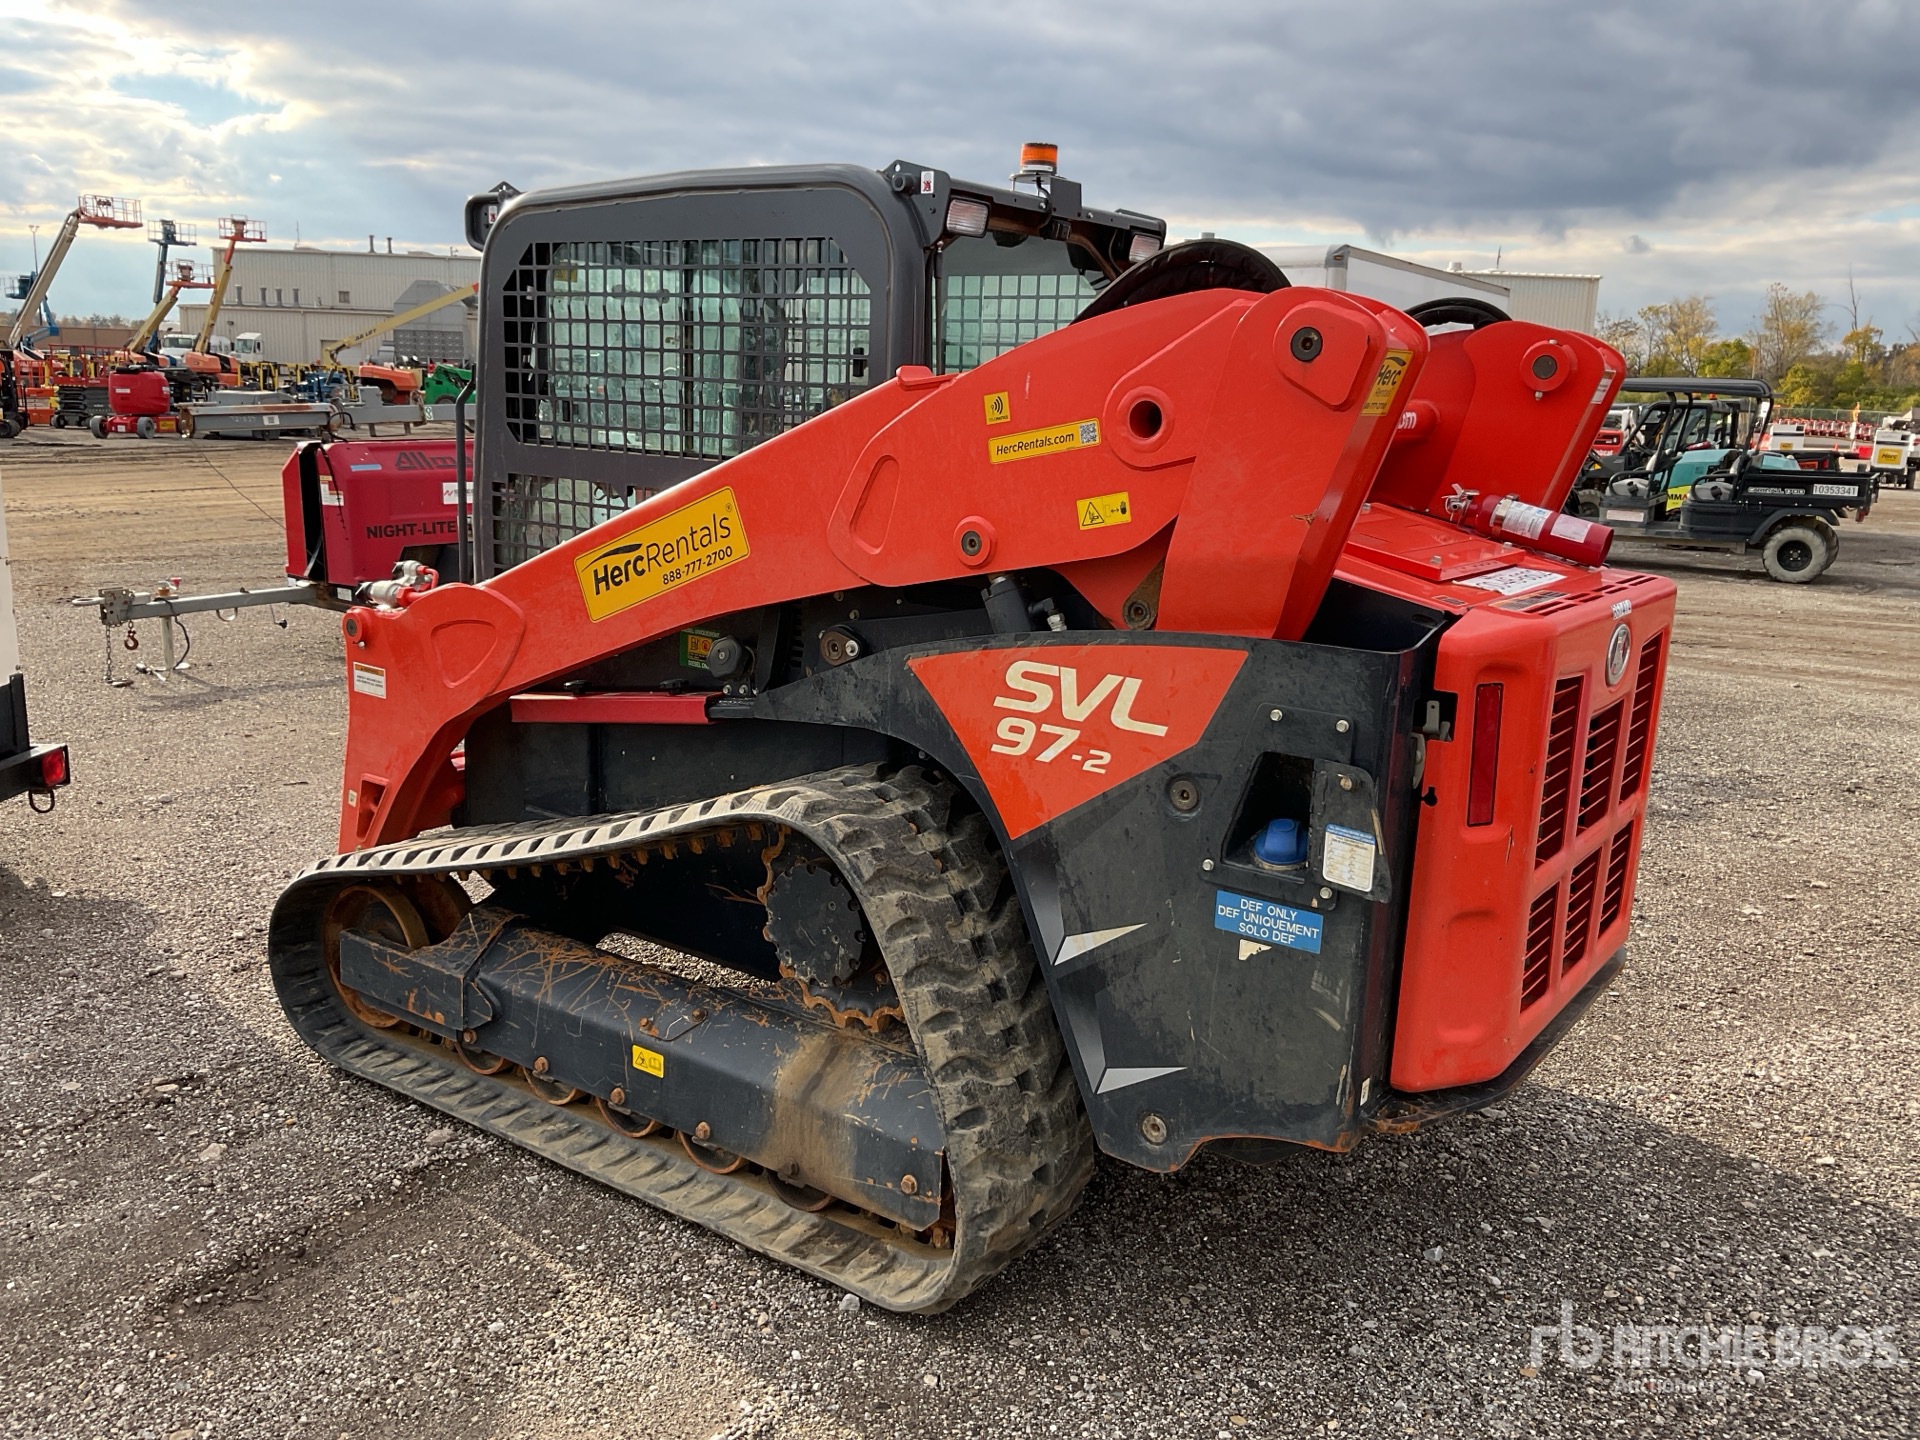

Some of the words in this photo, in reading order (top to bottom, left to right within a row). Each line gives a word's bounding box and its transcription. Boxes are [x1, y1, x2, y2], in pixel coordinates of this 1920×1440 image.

[1377, 364, 1402, 386] Herc
[996, 432, 1075, 456] HercRentals.com
[1814, 484, 1857, 496] 10353341
[366, 520, 457, 540] NIGHT-LITE
[662, 545, 734, 586] 888-777-2700
[993, 660, 1169, 737] SVL
[990, 716, 1112, 775] 97-2
[1240, 898, 1264, 912] DEF
[1267, 905, 1298, 921] ONLY
[1218, 904, 1240, 919] DEF
[1243, 911, 1320, 939] UNIQUEMENT
[1238, 922, 1269, 938] SOLO
[1272, 929, 1296, 945] DEF
